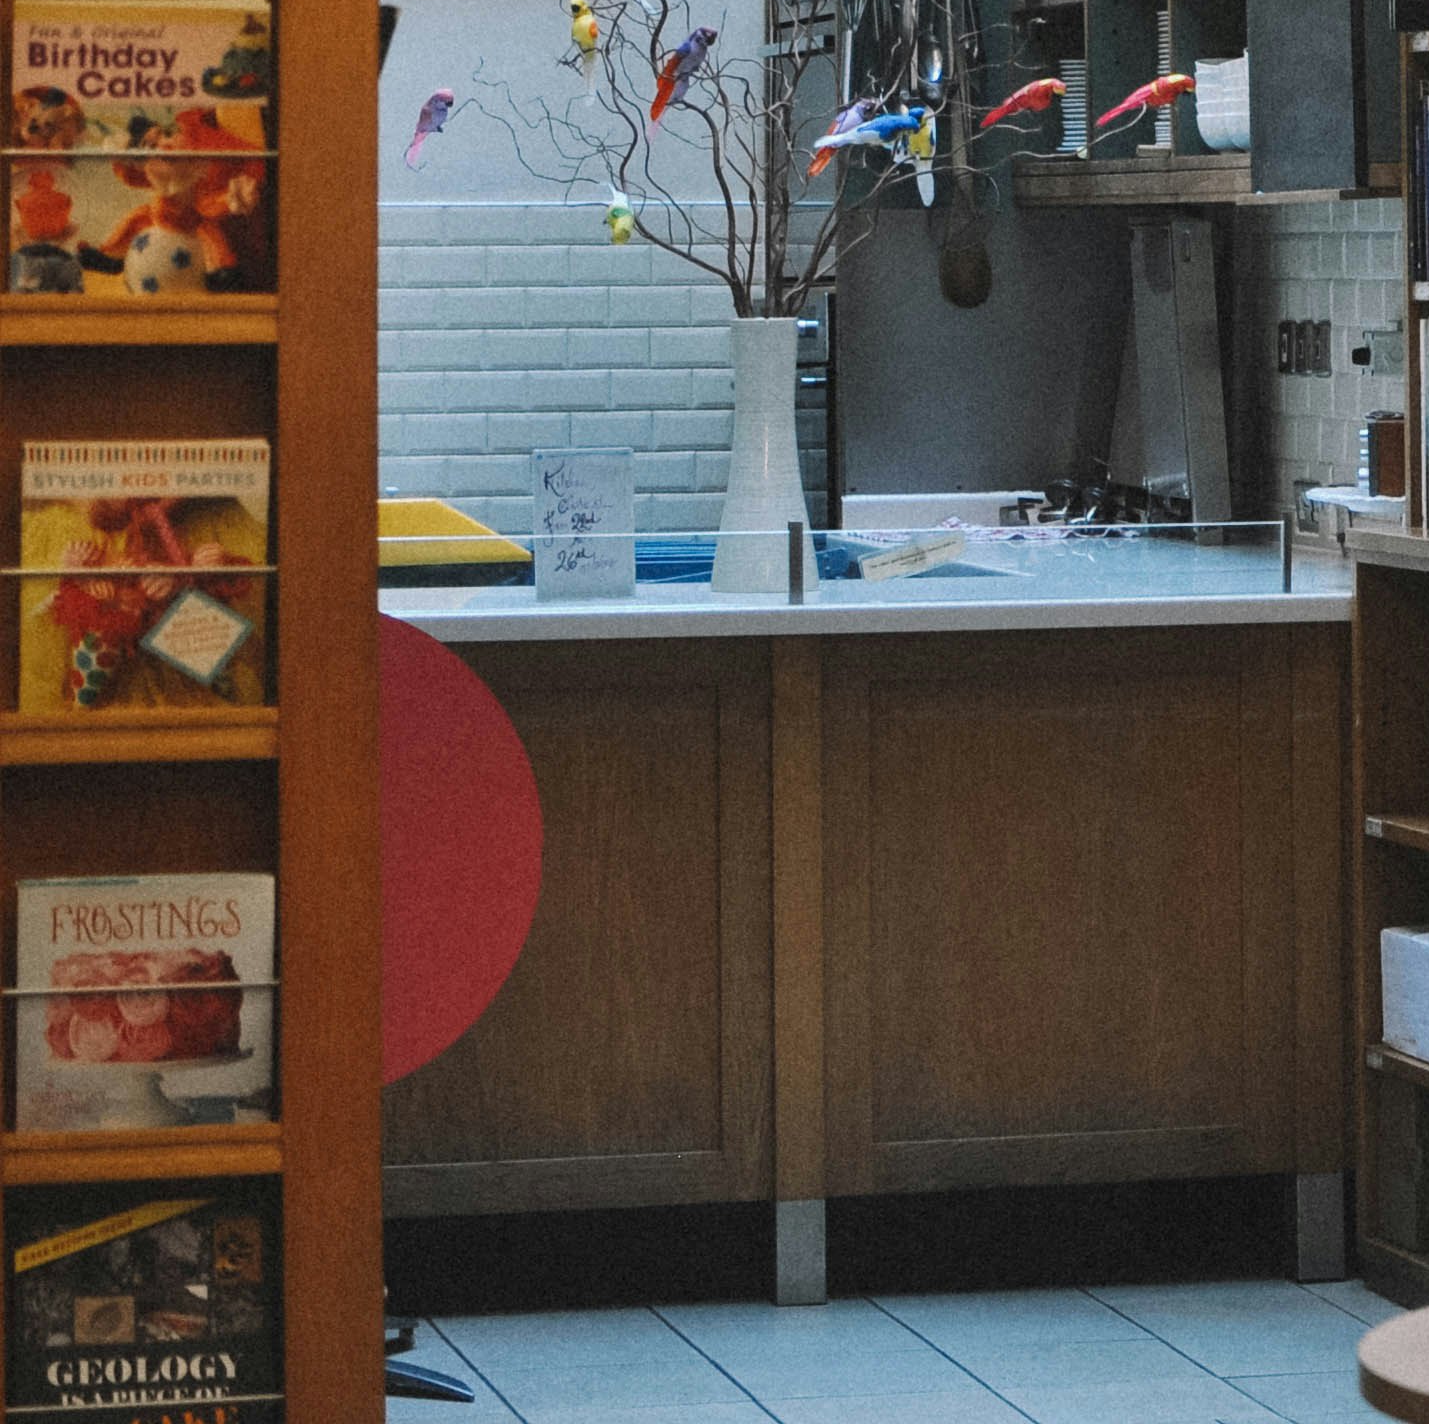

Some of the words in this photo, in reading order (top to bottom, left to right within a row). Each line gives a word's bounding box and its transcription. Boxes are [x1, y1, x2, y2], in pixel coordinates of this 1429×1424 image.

[28, 41, 179, 72] Birthday
[76, 70, 197, 99] Cakes
[120, 471, 170, 488] KIDS
[51, 894, 242, 946] FROSTINGS
[47, 1352, 238, 1387] GEOLOGY
